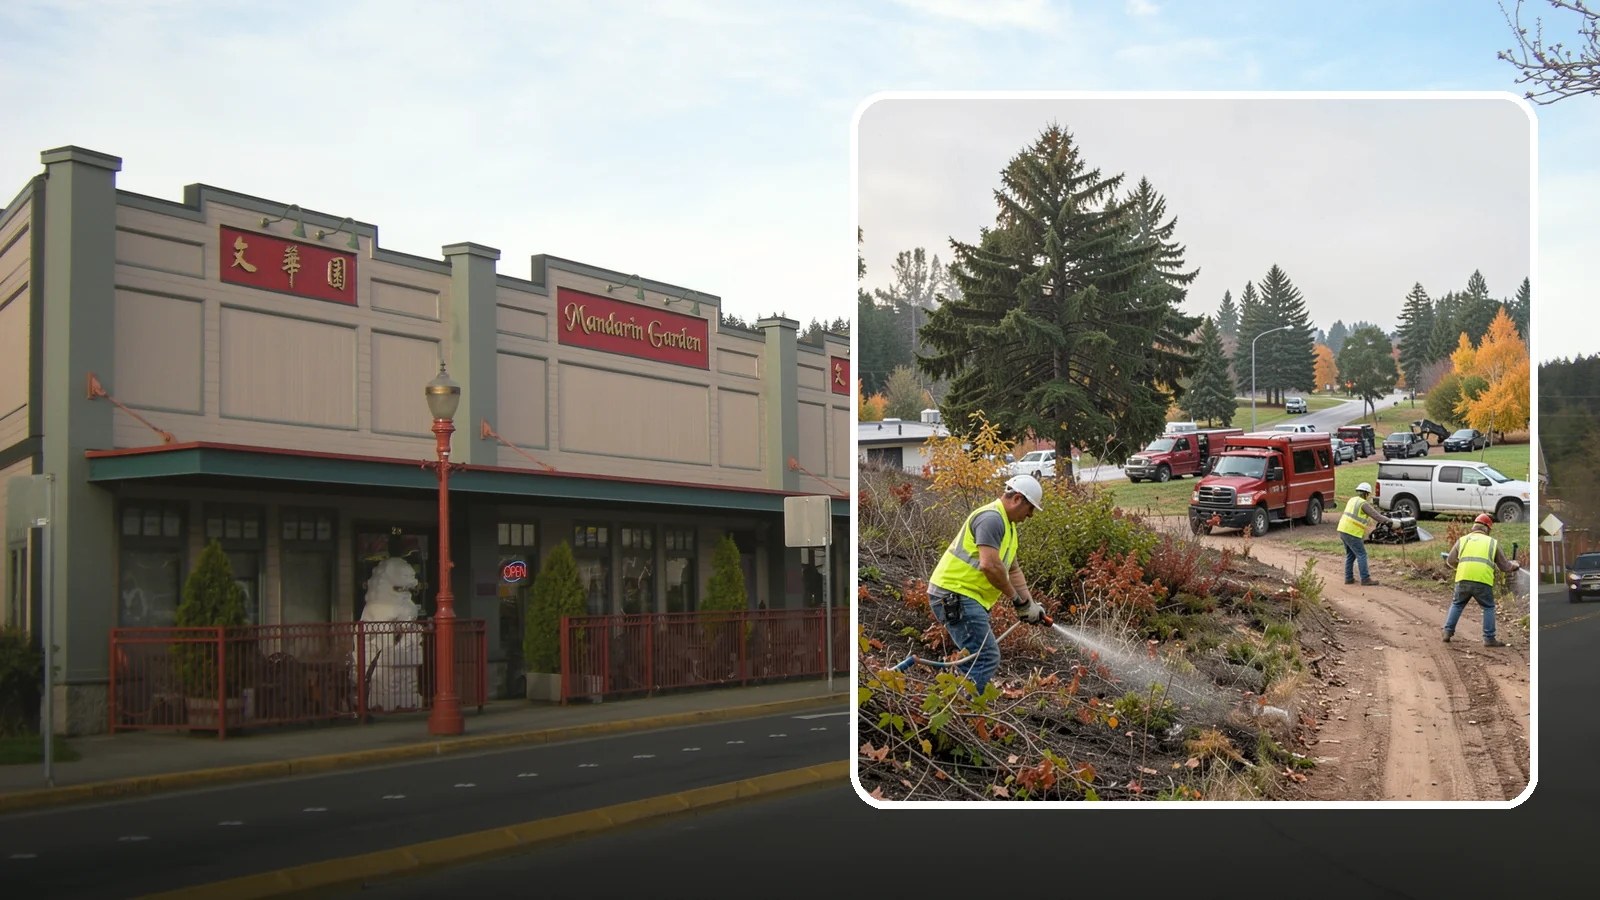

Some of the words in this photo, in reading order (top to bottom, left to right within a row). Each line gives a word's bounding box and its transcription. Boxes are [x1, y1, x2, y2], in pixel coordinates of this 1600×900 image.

[564, 302, 644, 341] Mandarin
[647, 320, 701, 352] Garden
[503, 565, 527, 578] OPEN
